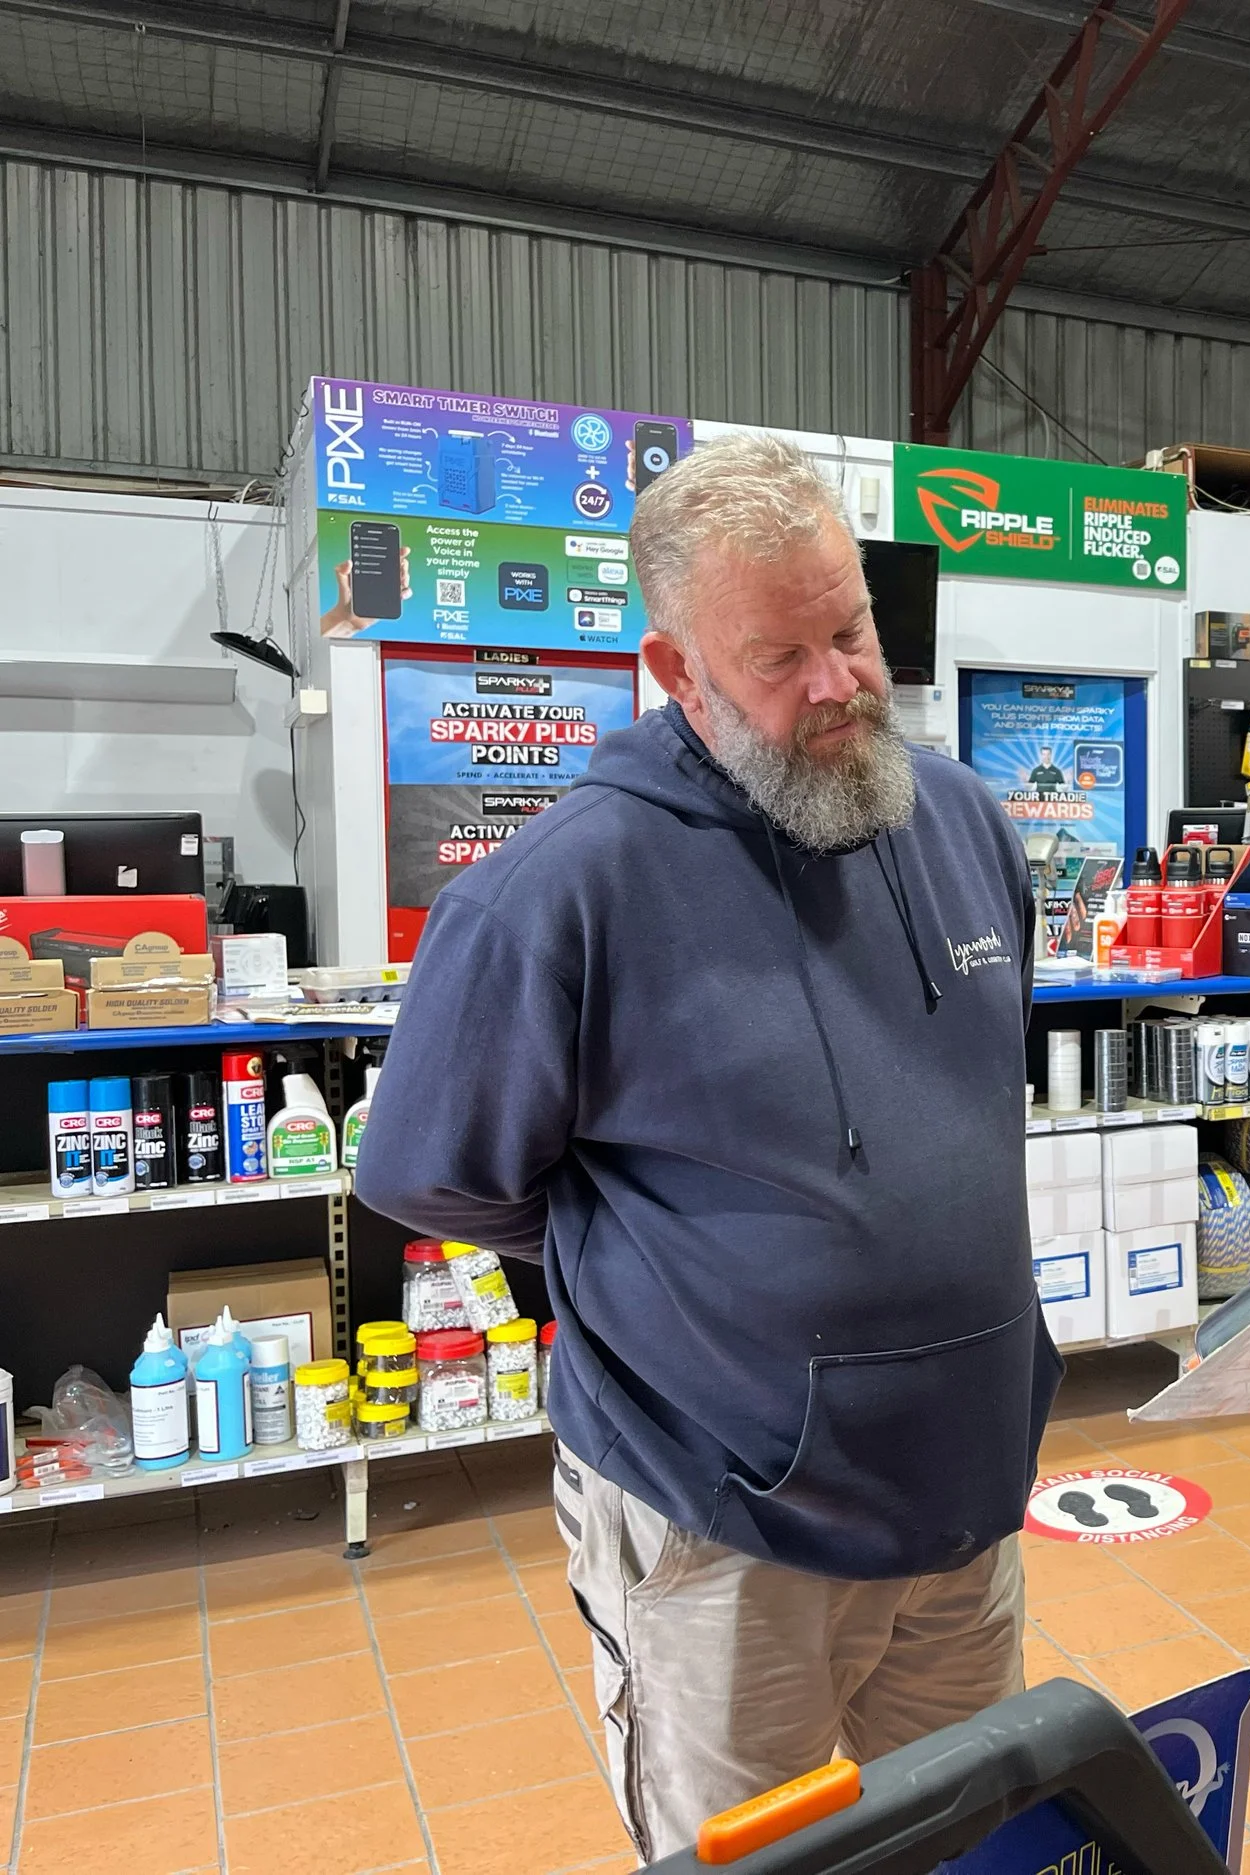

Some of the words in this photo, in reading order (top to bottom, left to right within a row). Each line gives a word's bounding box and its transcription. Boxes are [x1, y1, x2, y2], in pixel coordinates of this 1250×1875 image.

[373, 389, 435, 409] SMART
[437, 396, 490, 415] TIMER
[493, 402, 559, 422] SWITCH
[324, 384, 366, 490] PIXIE
[580, 495, 605, 507] 24/7
[1084, 496, 1170, 519] ELIMINATES
[961, 510, 1054, 535] RIPPLE
[1084, 512, 1132, 530] RIPPLE
[426, 525, 460, 537] Access
[462, 528, 479, 538] the
[1084, 526, 1152, 546] INDUCED
[430, 537, 462, 546] power
[464, 538, 476, 547] of
[985, 530, 1054, 550] SHIELD
[433, 546, 461, 557] Voice
[463, 548, 473, 557] in
[586, 546, 599, 555] Hey
[599, 547, 624, 556] Google
[426, 557, 450, 567] your
[451, 558, 480, 568] home
[437, 567, 470, 579] simply
[510, 571, 536, 580] WORKS
[515, 578, 533, 586] WITH
[504, 587, 543, 603] PIXIE
[584, 595, 626, 606] SmartThings
[433, 608, 470, 624] PIXIE
[587, 635, 619, 644] WATCH
[483, 651, 530, 664] LADIES
[478, 676, 536, 687] SPARKY
[1024, 684, 1064, 693] SPARKY
[443, 703, 534, 719] ACTIVATE
[540, 705, 584, 720] YOUR
[1003, 704, 1023, 712] CAN
[1049, 705, 1075, 713] EARN
[1076, 706, 1116, 715] SPARKY
[991, 712, 1016, 720] PLUS
[1018, 713, 1052, 721] POINTS
[1053, 714, 1079, 722] FROM
[1081, 715, 1105, 723] DATA
[994, 721, 1014, 729] AND
[1016, 722, 1048, 730] SOLAR
[431, 720, 528, 741] SPARKY
[535, 722, 596, 744] PLUS
[472, 745, 559, 765] POINTS
[494, 772, 539, 780] ACCELERATE
[484, 797, 541, 808] SPARKY
[1008, 791, 1040, 802] YOUR
[1043, 791, 1087, 803] TRADIE
[1001, 801, 1093, 819] REWARDS
[450, 825, 516, 840] ACTIVA
[105, 999, 124, 1008] HIGH
[126, 998, 159, 1007] QUALITY
[159, 997, 190, 1006] SOLDER
[0, 1006, 26, 1015] UALITY
[27, 1004, 58, 1013] SOLDER
[191, 1107, 215, 1118] CRC
[240, 1102, 265, 1117] LEA
[60, 1118, 86, 1128] CRC
[96, 1117, 121, 1127] CRC
[136, 1115, 161, 1125] CRC
[241, 1116, 265, 1128] STO
[286, 1121, 316, 1131] CRC
[190, 1121, 217, 1132] Black
[135, 1127, 163, 1139] Black
[57, 1133, 90, 1152] ZINC
[93, 1132, 126, 1152] ZINC
[135, 1139, 166, 1155] Zinc
[188, 1133, 219, 1149] Zinc
[65, 1151, 81, 1168] IT
[100, 1150, 116, 1166] IT
[1030, 1472, 1086, 1497] NTAIN
[1091, 1468, 1174, 1485] SOCIAL
[1077, 1514, 1199, 1543] DISTANCING
